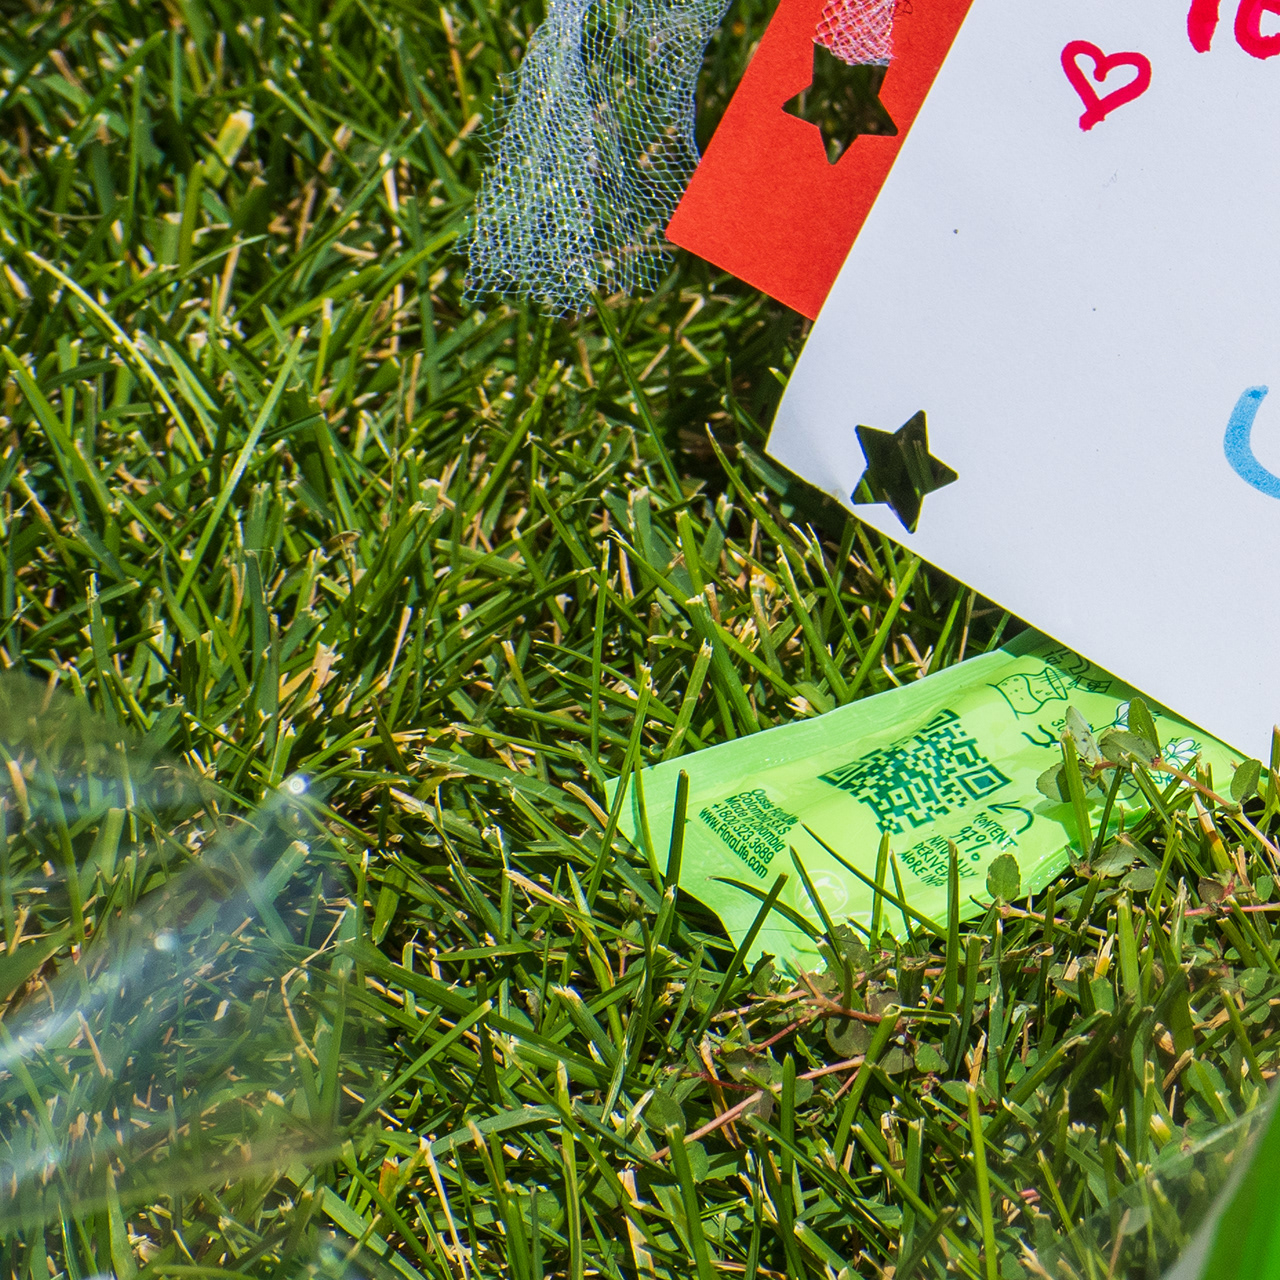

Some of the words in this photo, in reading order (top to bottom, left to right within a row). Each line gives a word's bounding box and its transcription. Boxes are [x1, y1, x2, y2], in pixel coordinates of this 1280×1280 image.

[725, 795, 748, 818] Made
[699, 807, 768, 879] www.FloraLife.com
[925, 835, 979, 878] NATUALLY
[949, 826, 991, 861] 97%
[898, 850, 928, 877] MORE
